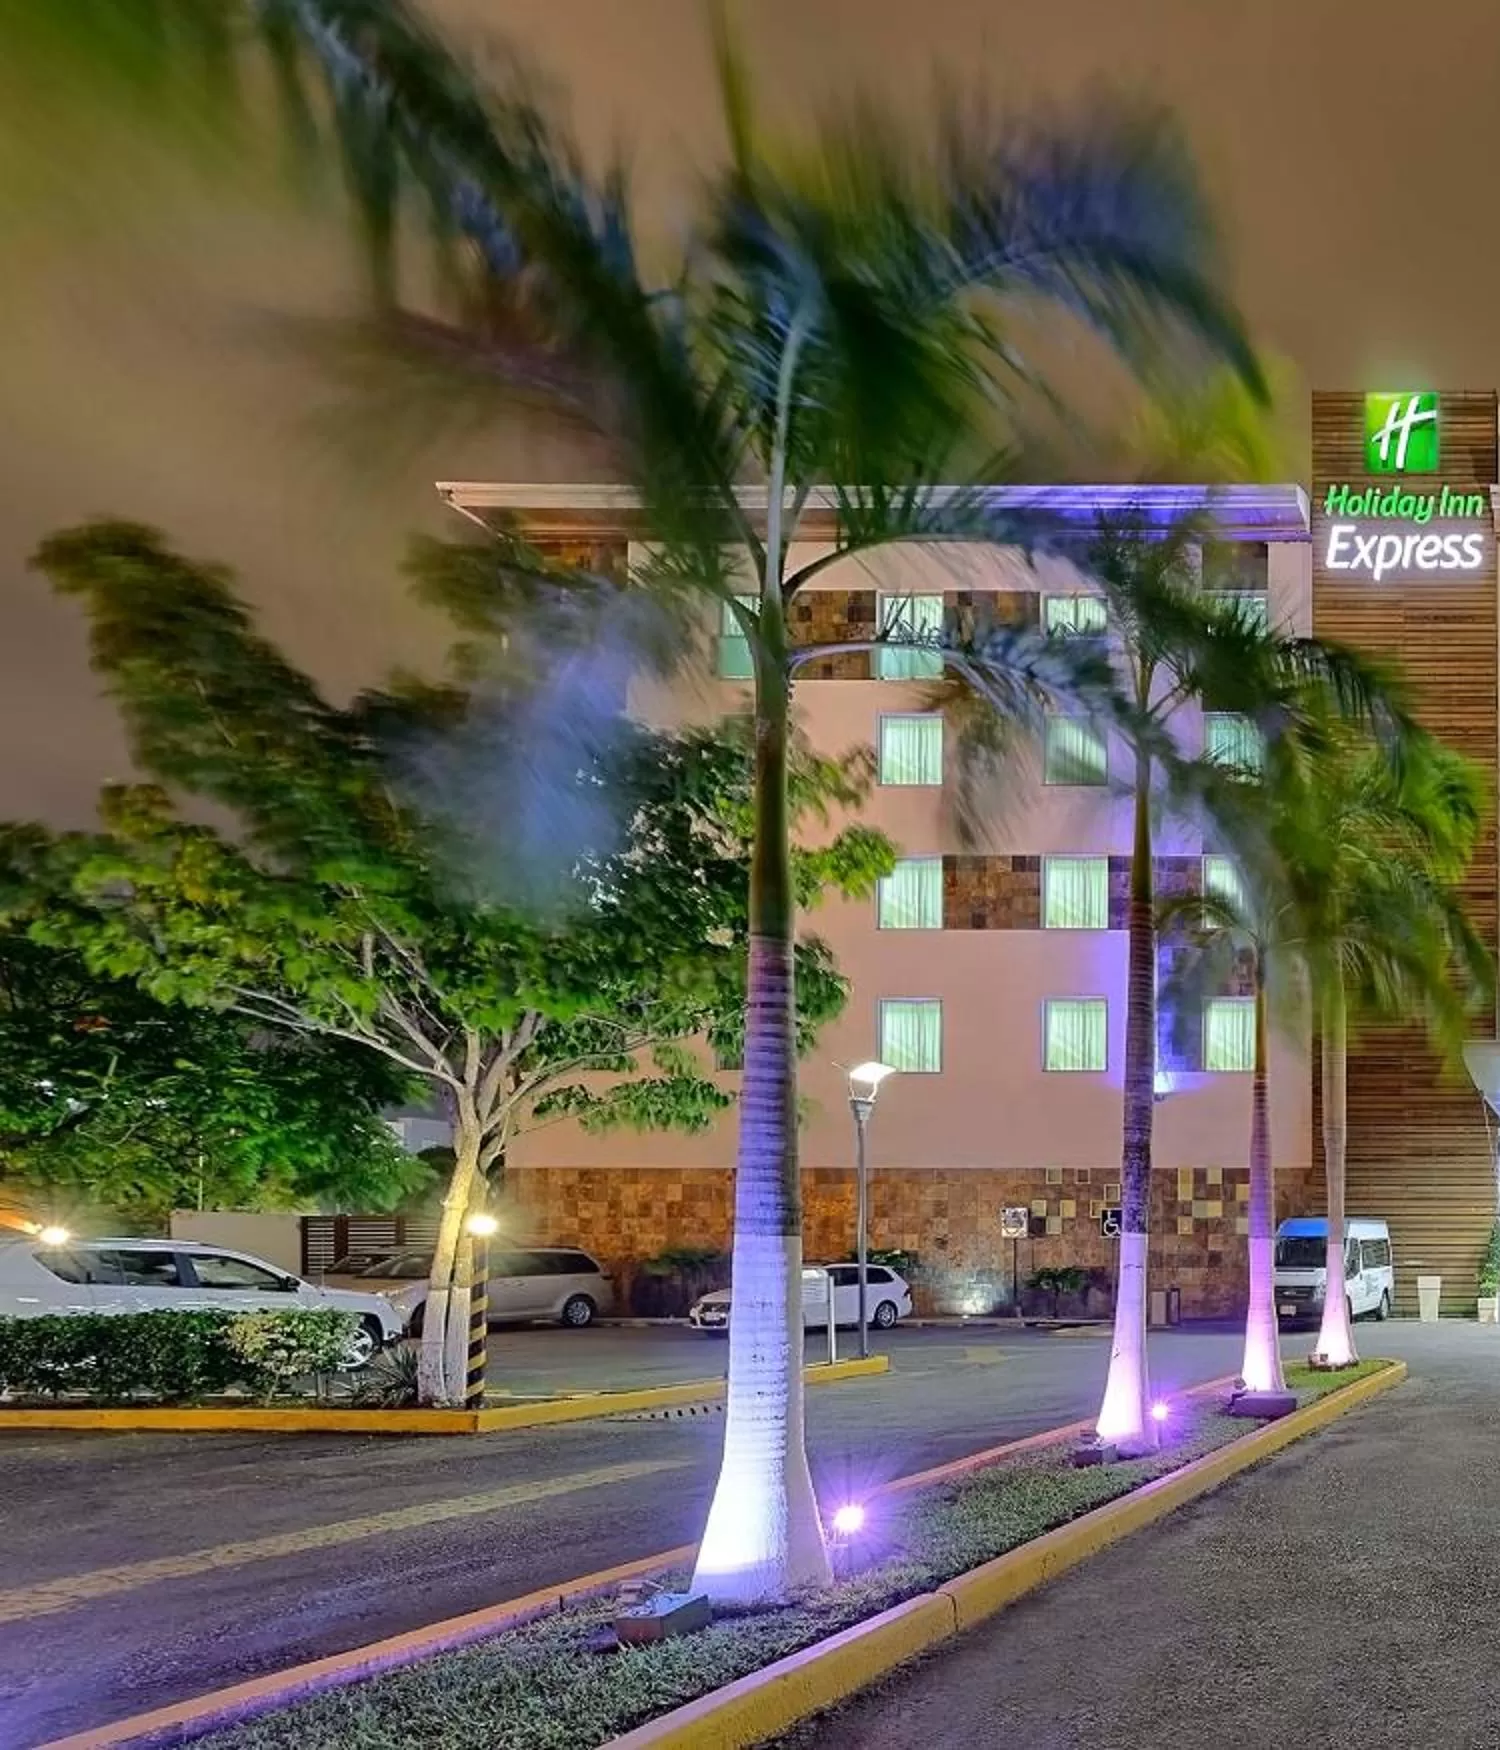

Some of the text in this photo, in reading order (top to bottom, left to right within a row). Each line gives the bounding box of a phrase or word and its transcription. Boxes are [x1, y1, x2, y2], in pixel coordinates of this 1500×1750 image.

[1371, 395, 1438, 469] H
[1324, 485, 1484, 524] Holiday Inn
[1325, 524, 1484, 581] Express
